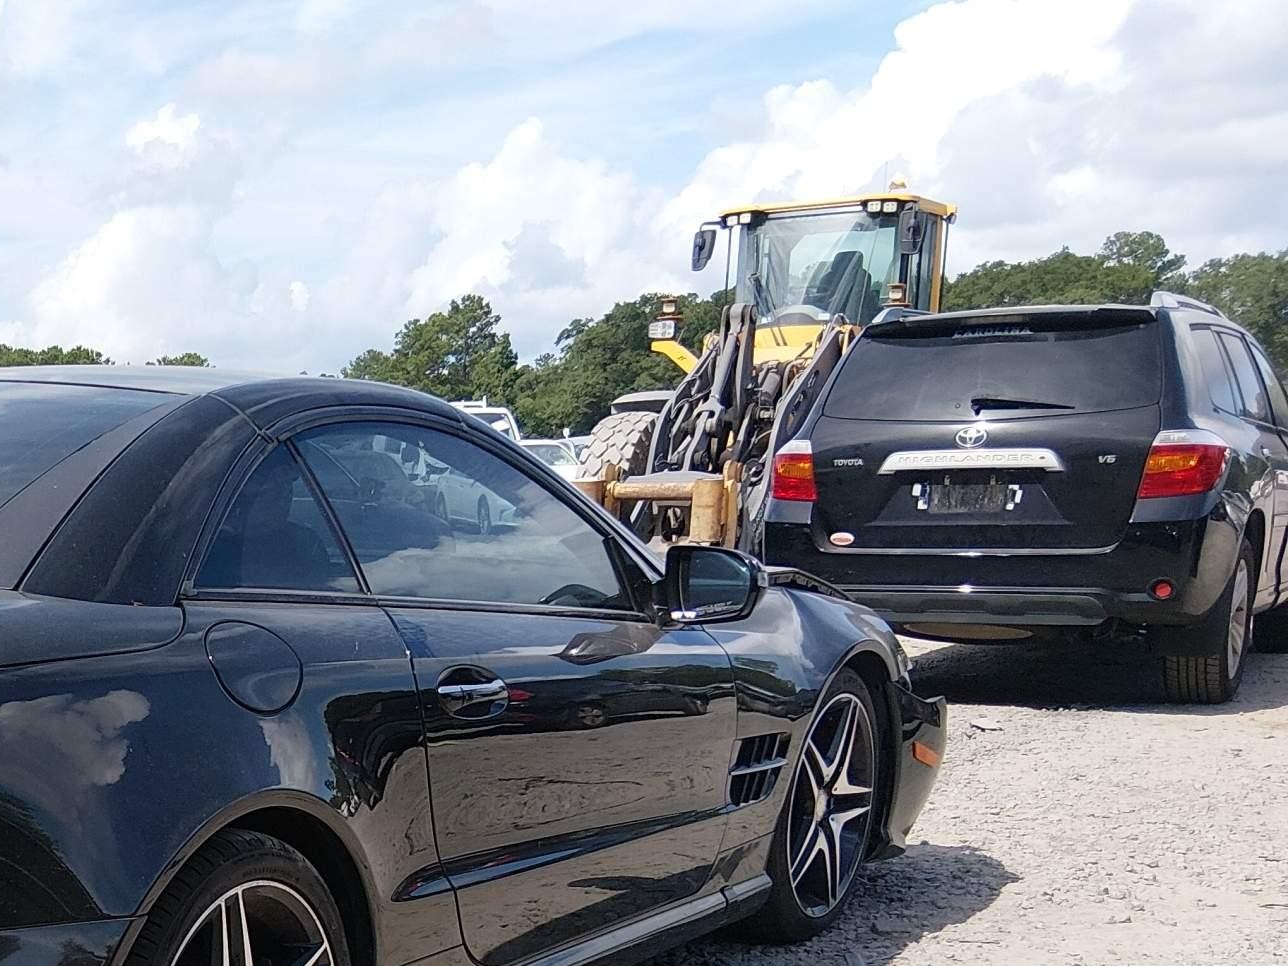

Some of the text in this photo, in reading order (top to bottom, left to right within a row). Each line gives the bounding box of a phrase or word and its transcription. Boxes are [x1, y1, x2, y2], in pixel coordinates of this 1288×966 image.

[832, 458, 863, 467] TOYOTA
[897, 453, 1035, 464] HIGHLANDER
[1097, 454, 1117, 464] V6
